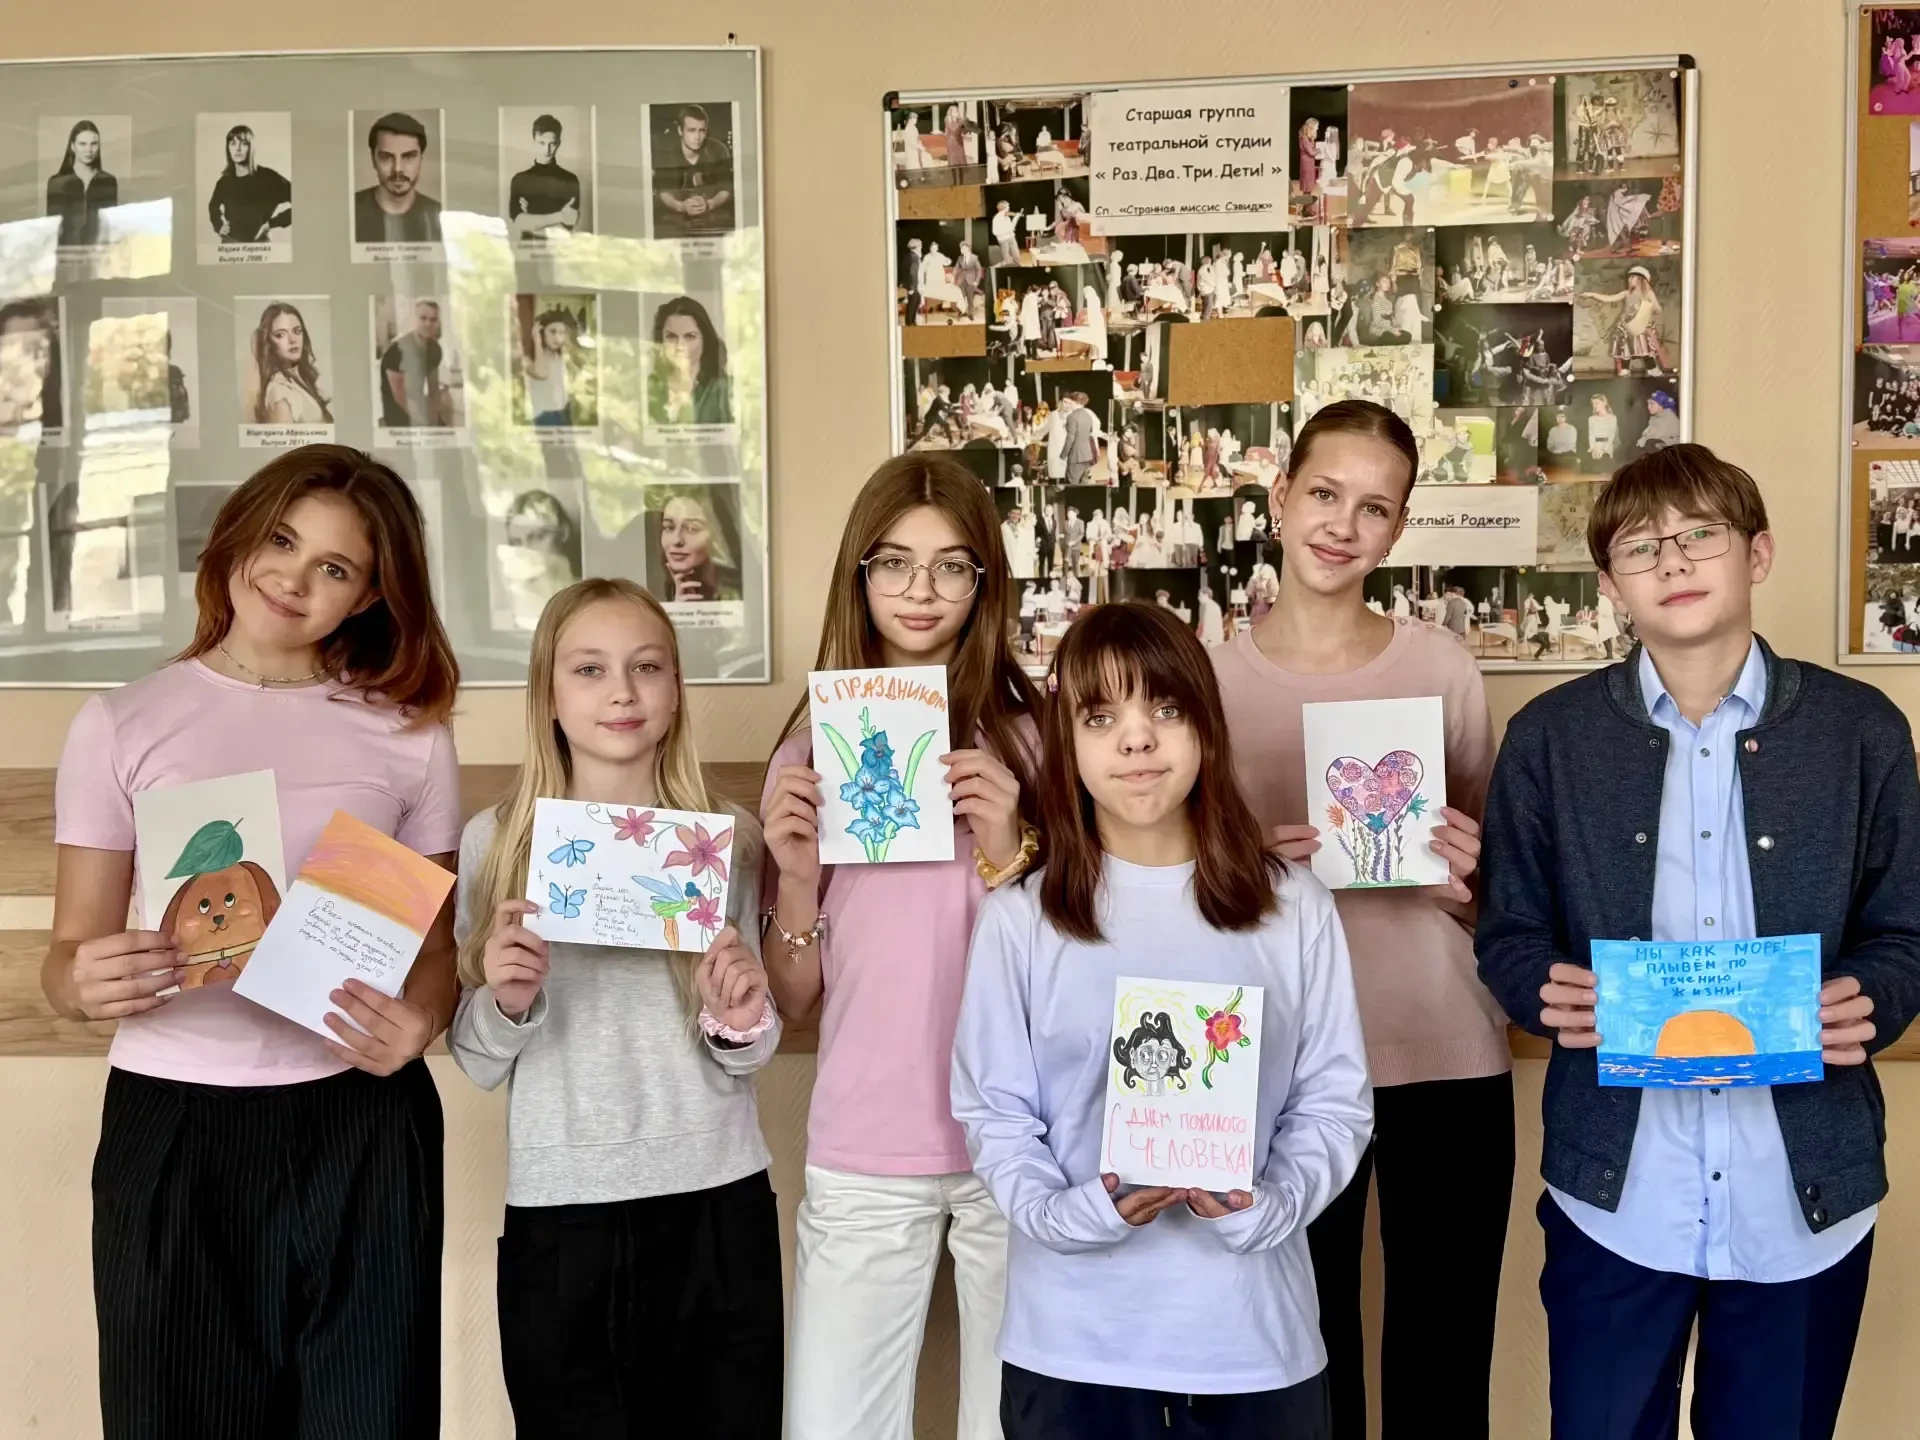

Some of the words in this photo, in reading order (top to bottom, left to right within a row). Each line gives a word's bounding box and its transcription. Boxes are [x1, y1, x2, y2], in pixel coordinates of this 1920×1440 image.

[1126, 108, 1192, 124] Старшая
[1199, 107, 1256, 123] группа
[1108, 134, 1209, 154] театральной
[1216, 136, 1272, 152] студии
[1119, 205, 1176, 217] «Странная
[1180, 204, 1221, 213] миссис
[1225, 201, 1273, 214] Сэвидж»
[1403, 511, 1455, 527] еселый
[1461, 514, 1521, 529] Роджер»
[815, 683, 829, 704] С
[834, 675, 947, 712] ПРАЗДНИКОМ
[1636, 947, 1662, 960] МЫ
[1680, 945, 1716, 959] КАК
[1734, 939, 1787, 955] МОРЕ!
[1728, 958, 1747, 970] ПО
[1125, 1107, 1172, 1129] ДНЕМ
[1180, 1113, 1247, 1133] ПОЖИЛОГО
[1129, 1132, 1252, 1175] ЧЕЛОВЕКА!
